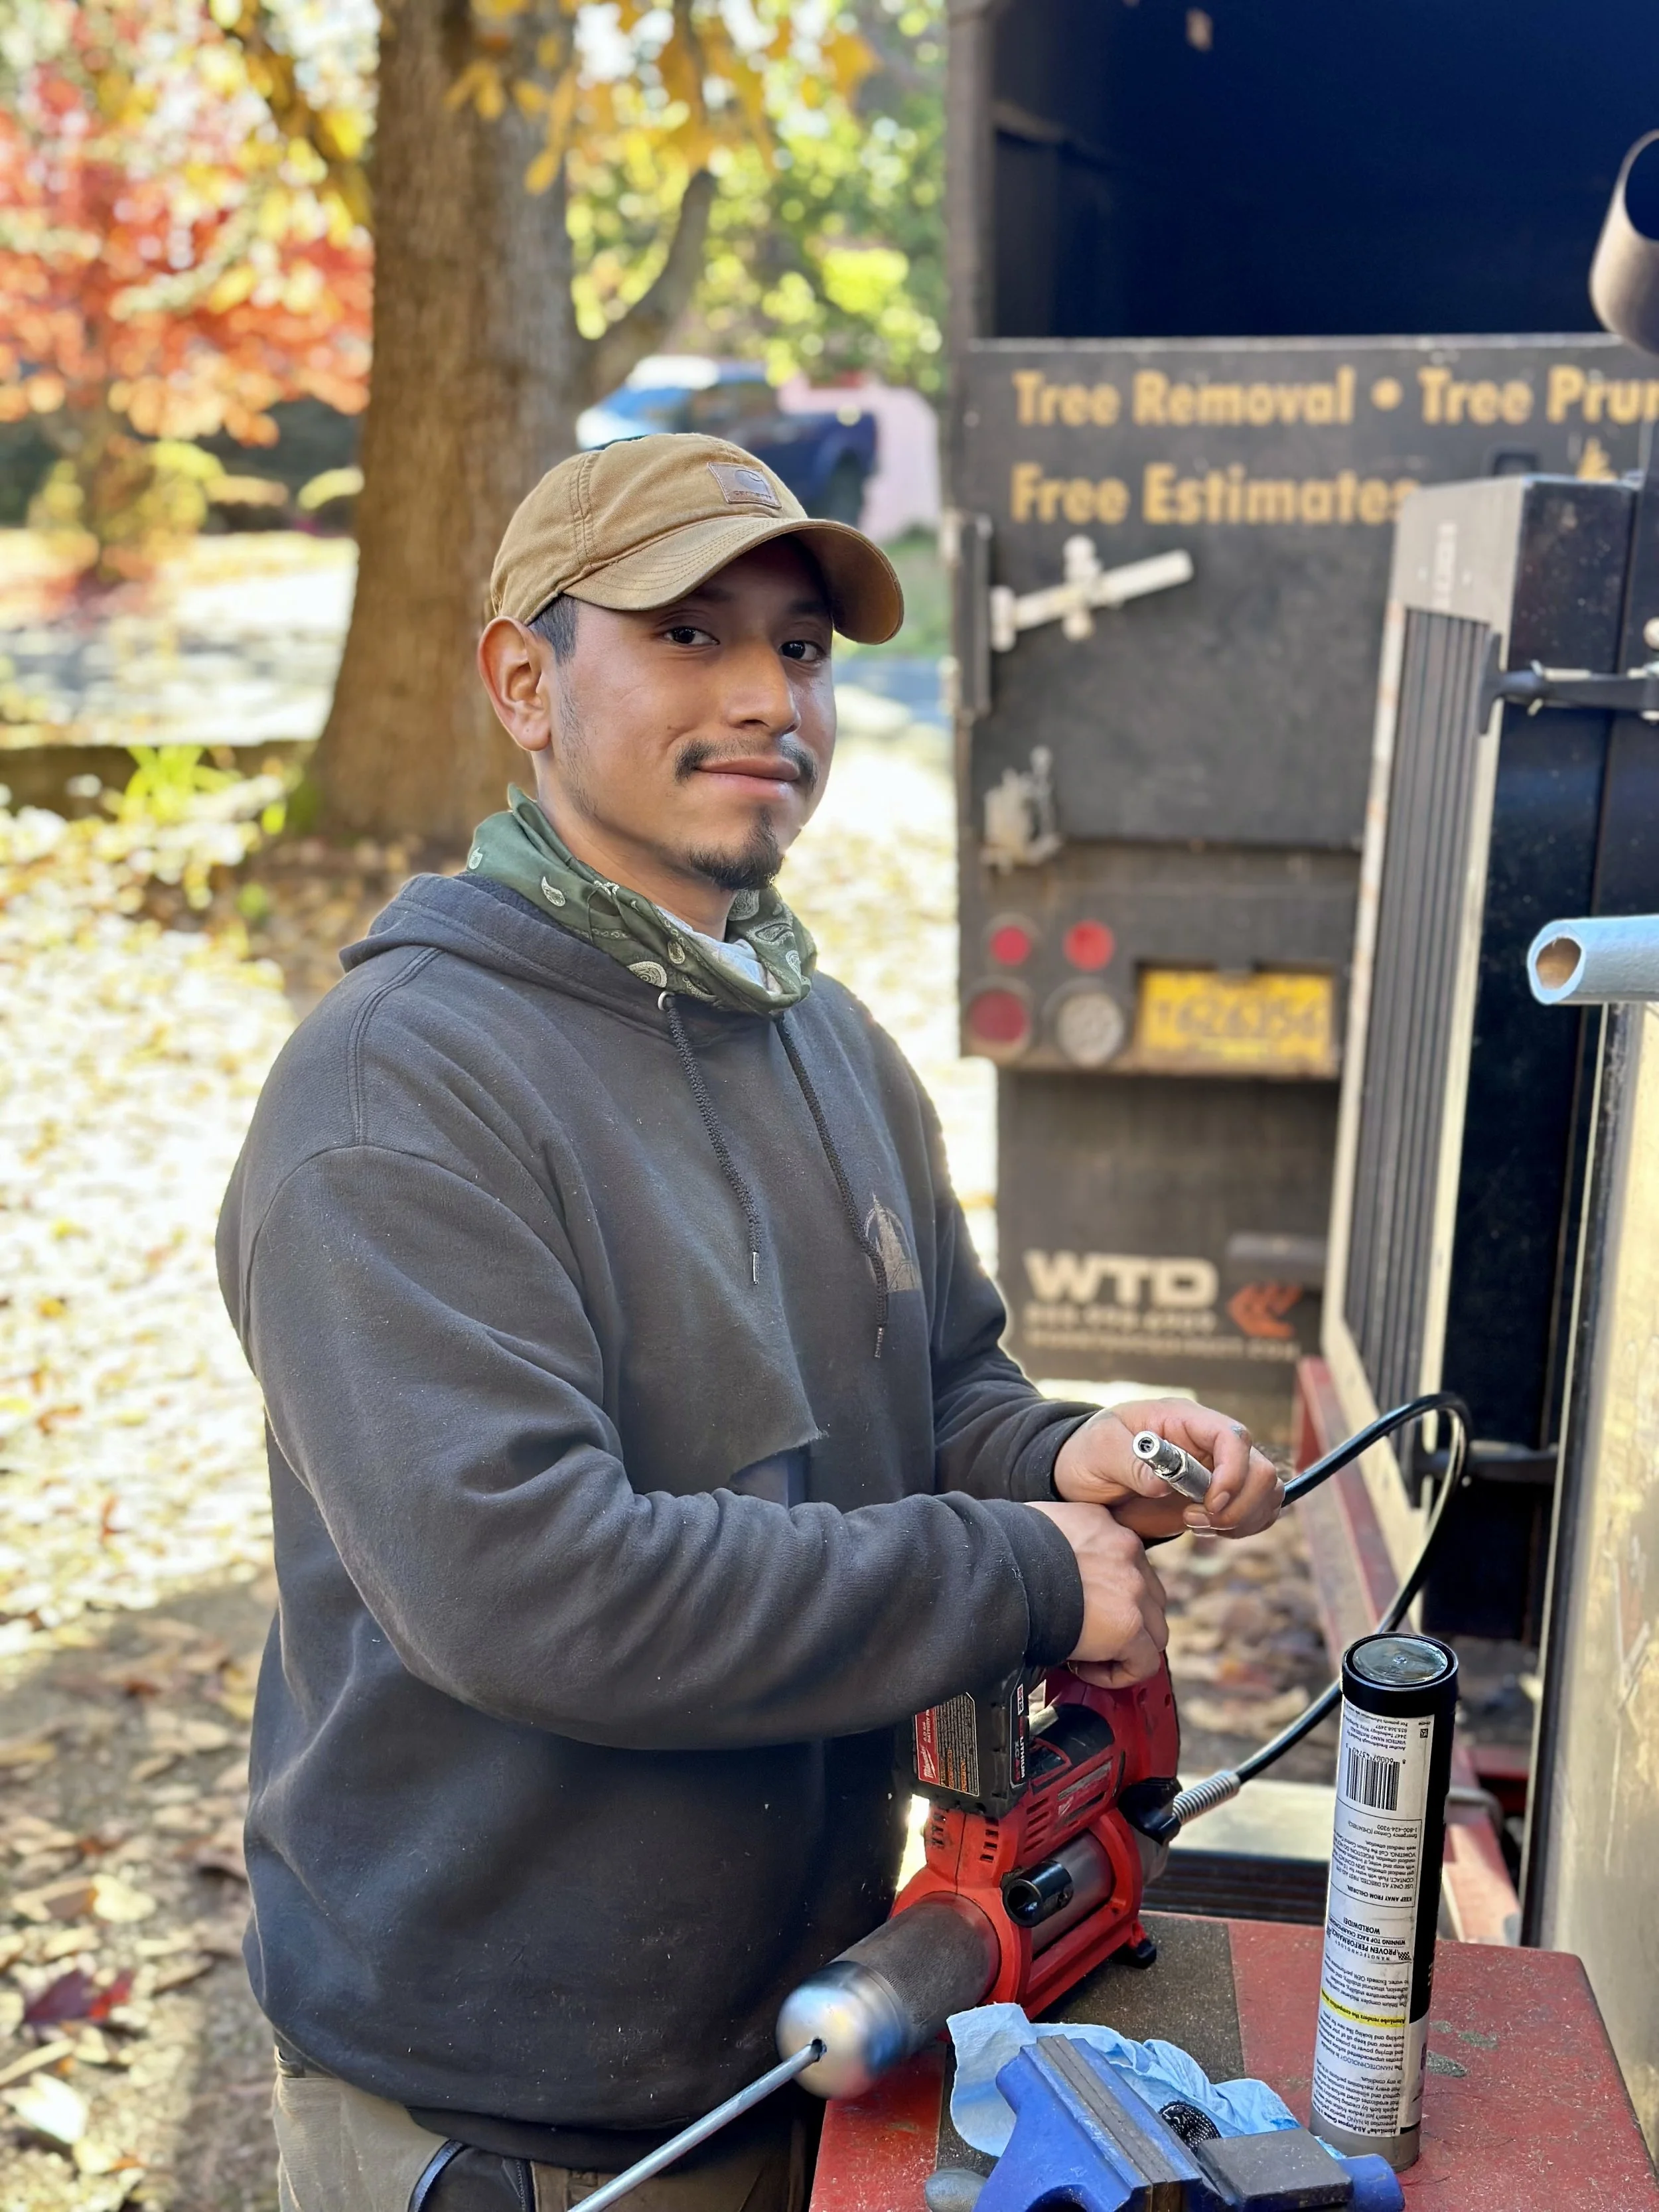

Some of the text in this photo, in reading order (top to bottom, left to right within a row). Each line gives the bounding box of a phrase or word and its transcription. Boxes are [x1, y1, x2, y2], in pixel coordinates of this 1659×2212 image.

[1012, 370, 1120, 427] Tree
[1133, 365, 1356, 426] Removal
[1418, 367, 1532, 426] Tree
[1011, 463, 1129, 525] Free
[1370, 1728, 1394, 1737] Technology
[1373, 1755, 1394, 1764] 60007
[1376, 1824, 1417, 1832] 1-800-424-9300
[1343, 1919, 1380, 1935] WORLDWIDE!
[1331, 1928, 1396, 1955] PROVEN PERFORMANCE
[1355, 2029, 1373, 2040] looking
[1347, 2050, 1384, 2061] unprecedented
[1340, 2055, 1393, 2071] NANOTECHNOLOGY
